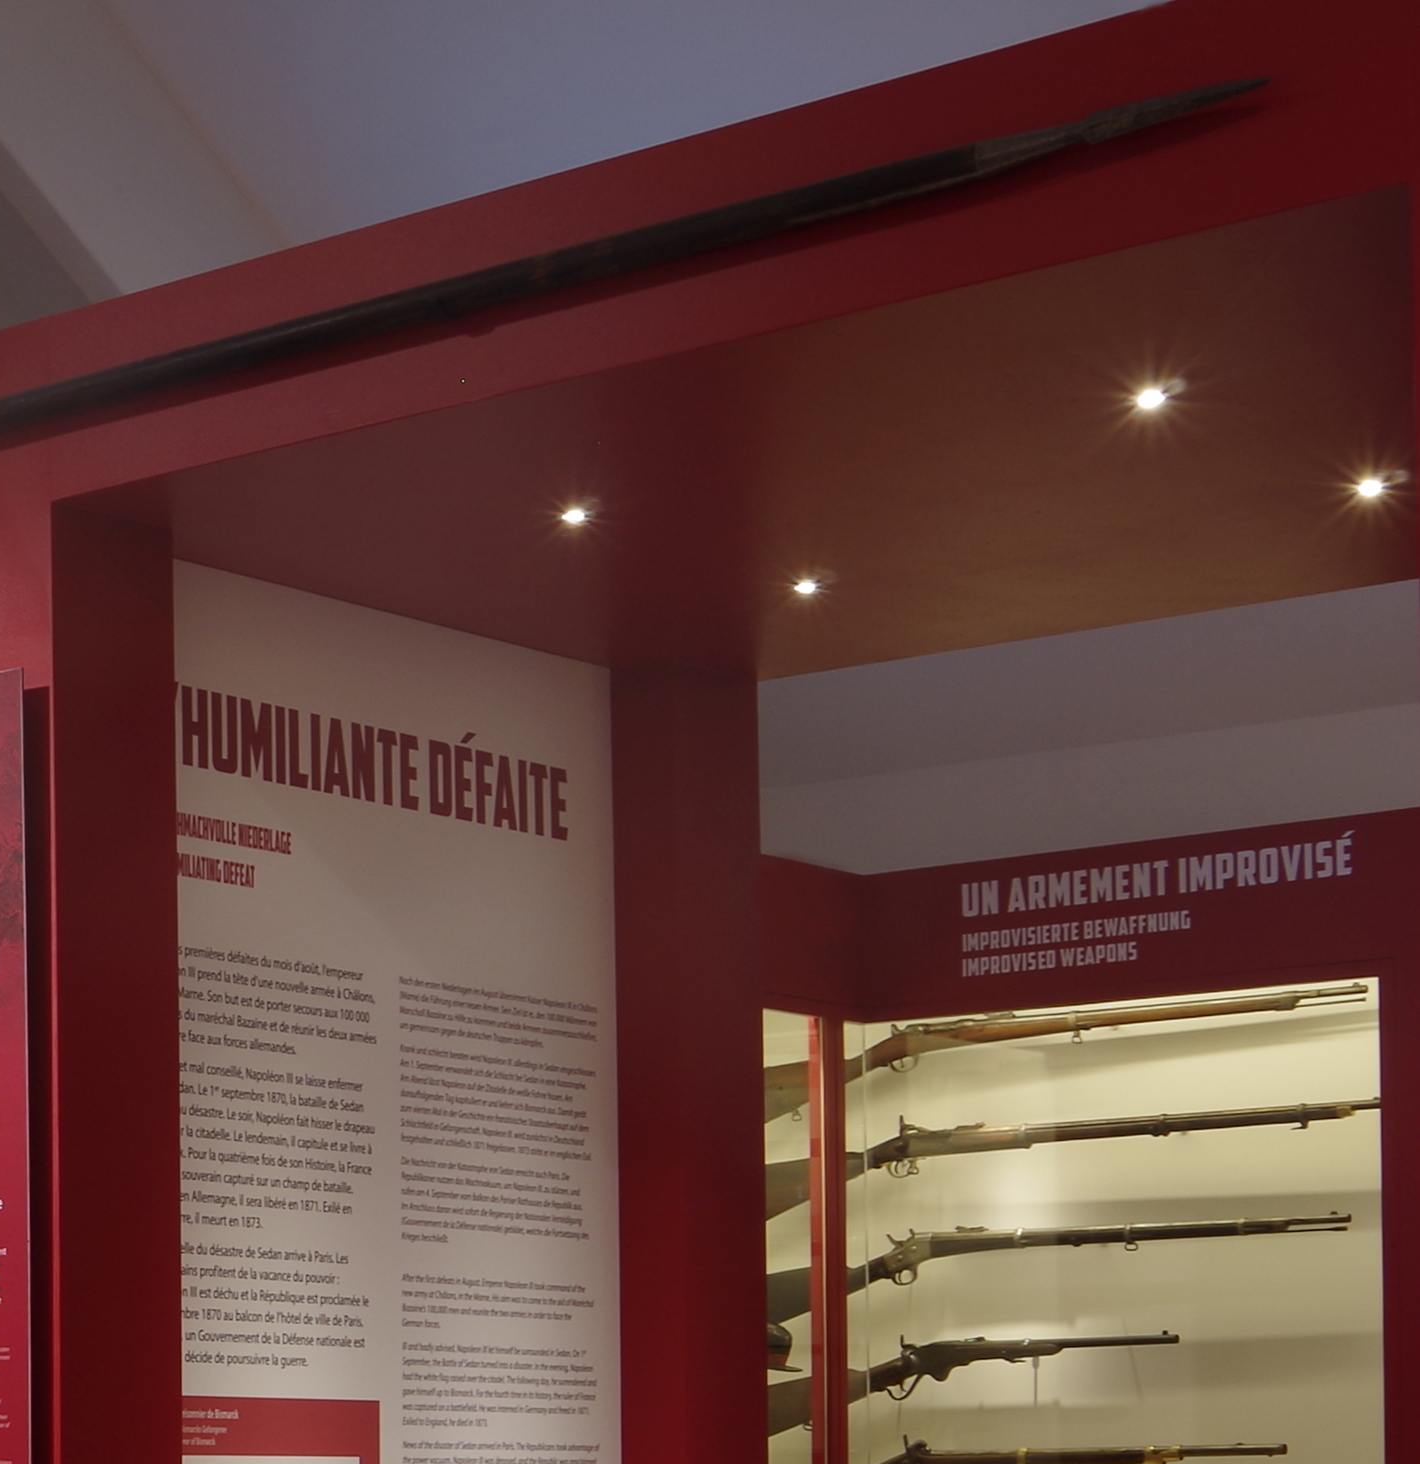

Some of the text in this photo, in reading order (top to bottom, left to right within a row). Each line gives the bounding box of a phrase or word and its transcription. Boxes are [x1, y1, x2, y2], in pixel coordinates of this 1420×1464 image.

[429, 732, 569, 841] DÉFAITE
[237, 822, 291, 855] NIEDERLAGE
[222, 860, 255, 888] DEFEAT
[960, 830, 1355, 917] UN ARMEMENT IMPROVISÉ
[961, 909, 1191, 952] IMPROVISIERTE BEWAFFNUNG
[961, 941, 1137, 977] IMPROVISED WEAPONS
